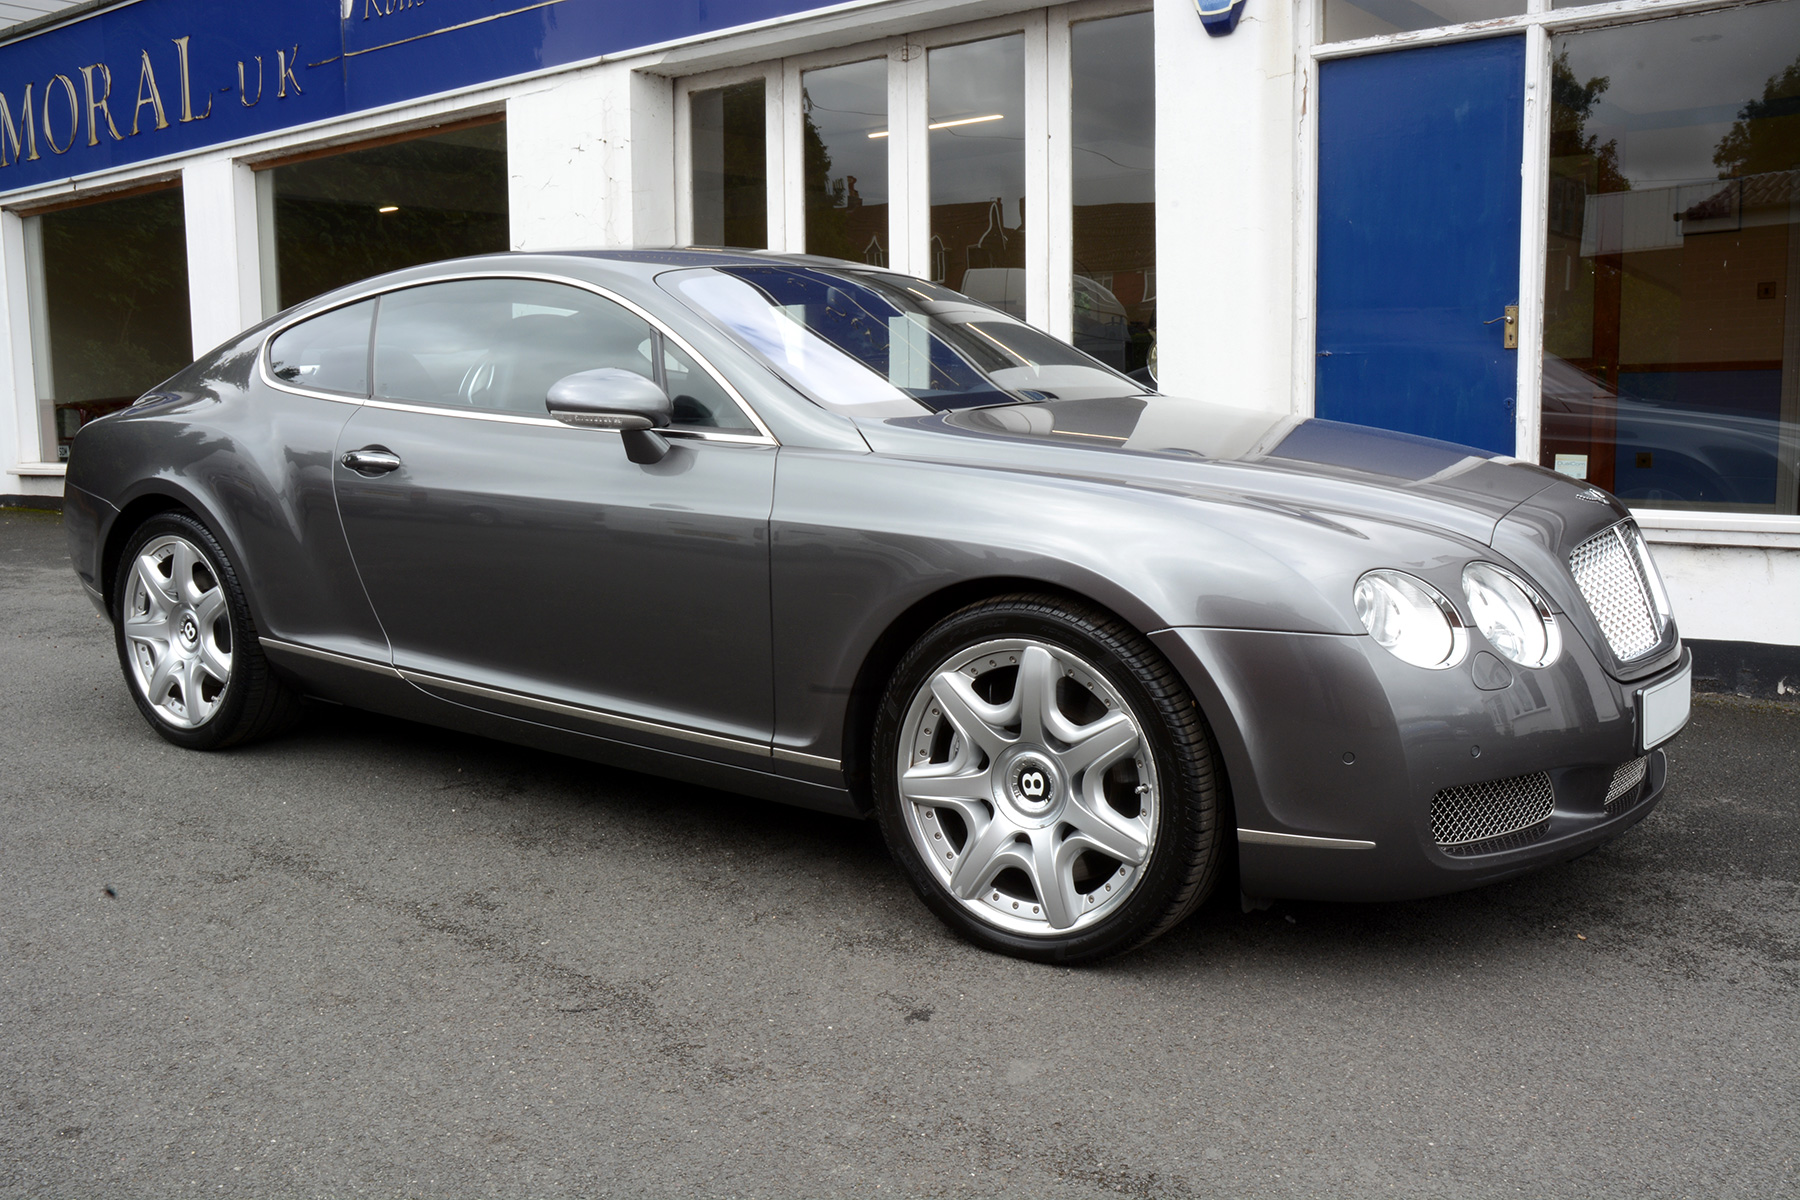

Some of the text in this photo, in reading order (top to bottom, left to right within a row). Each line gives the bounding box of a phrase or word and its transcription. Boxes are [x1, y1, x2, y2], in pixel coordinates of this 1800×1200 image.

[237, 43, 303, 107] UK
[184, 621, 196, 640] B
[1021, 771, 1045, 797] B
